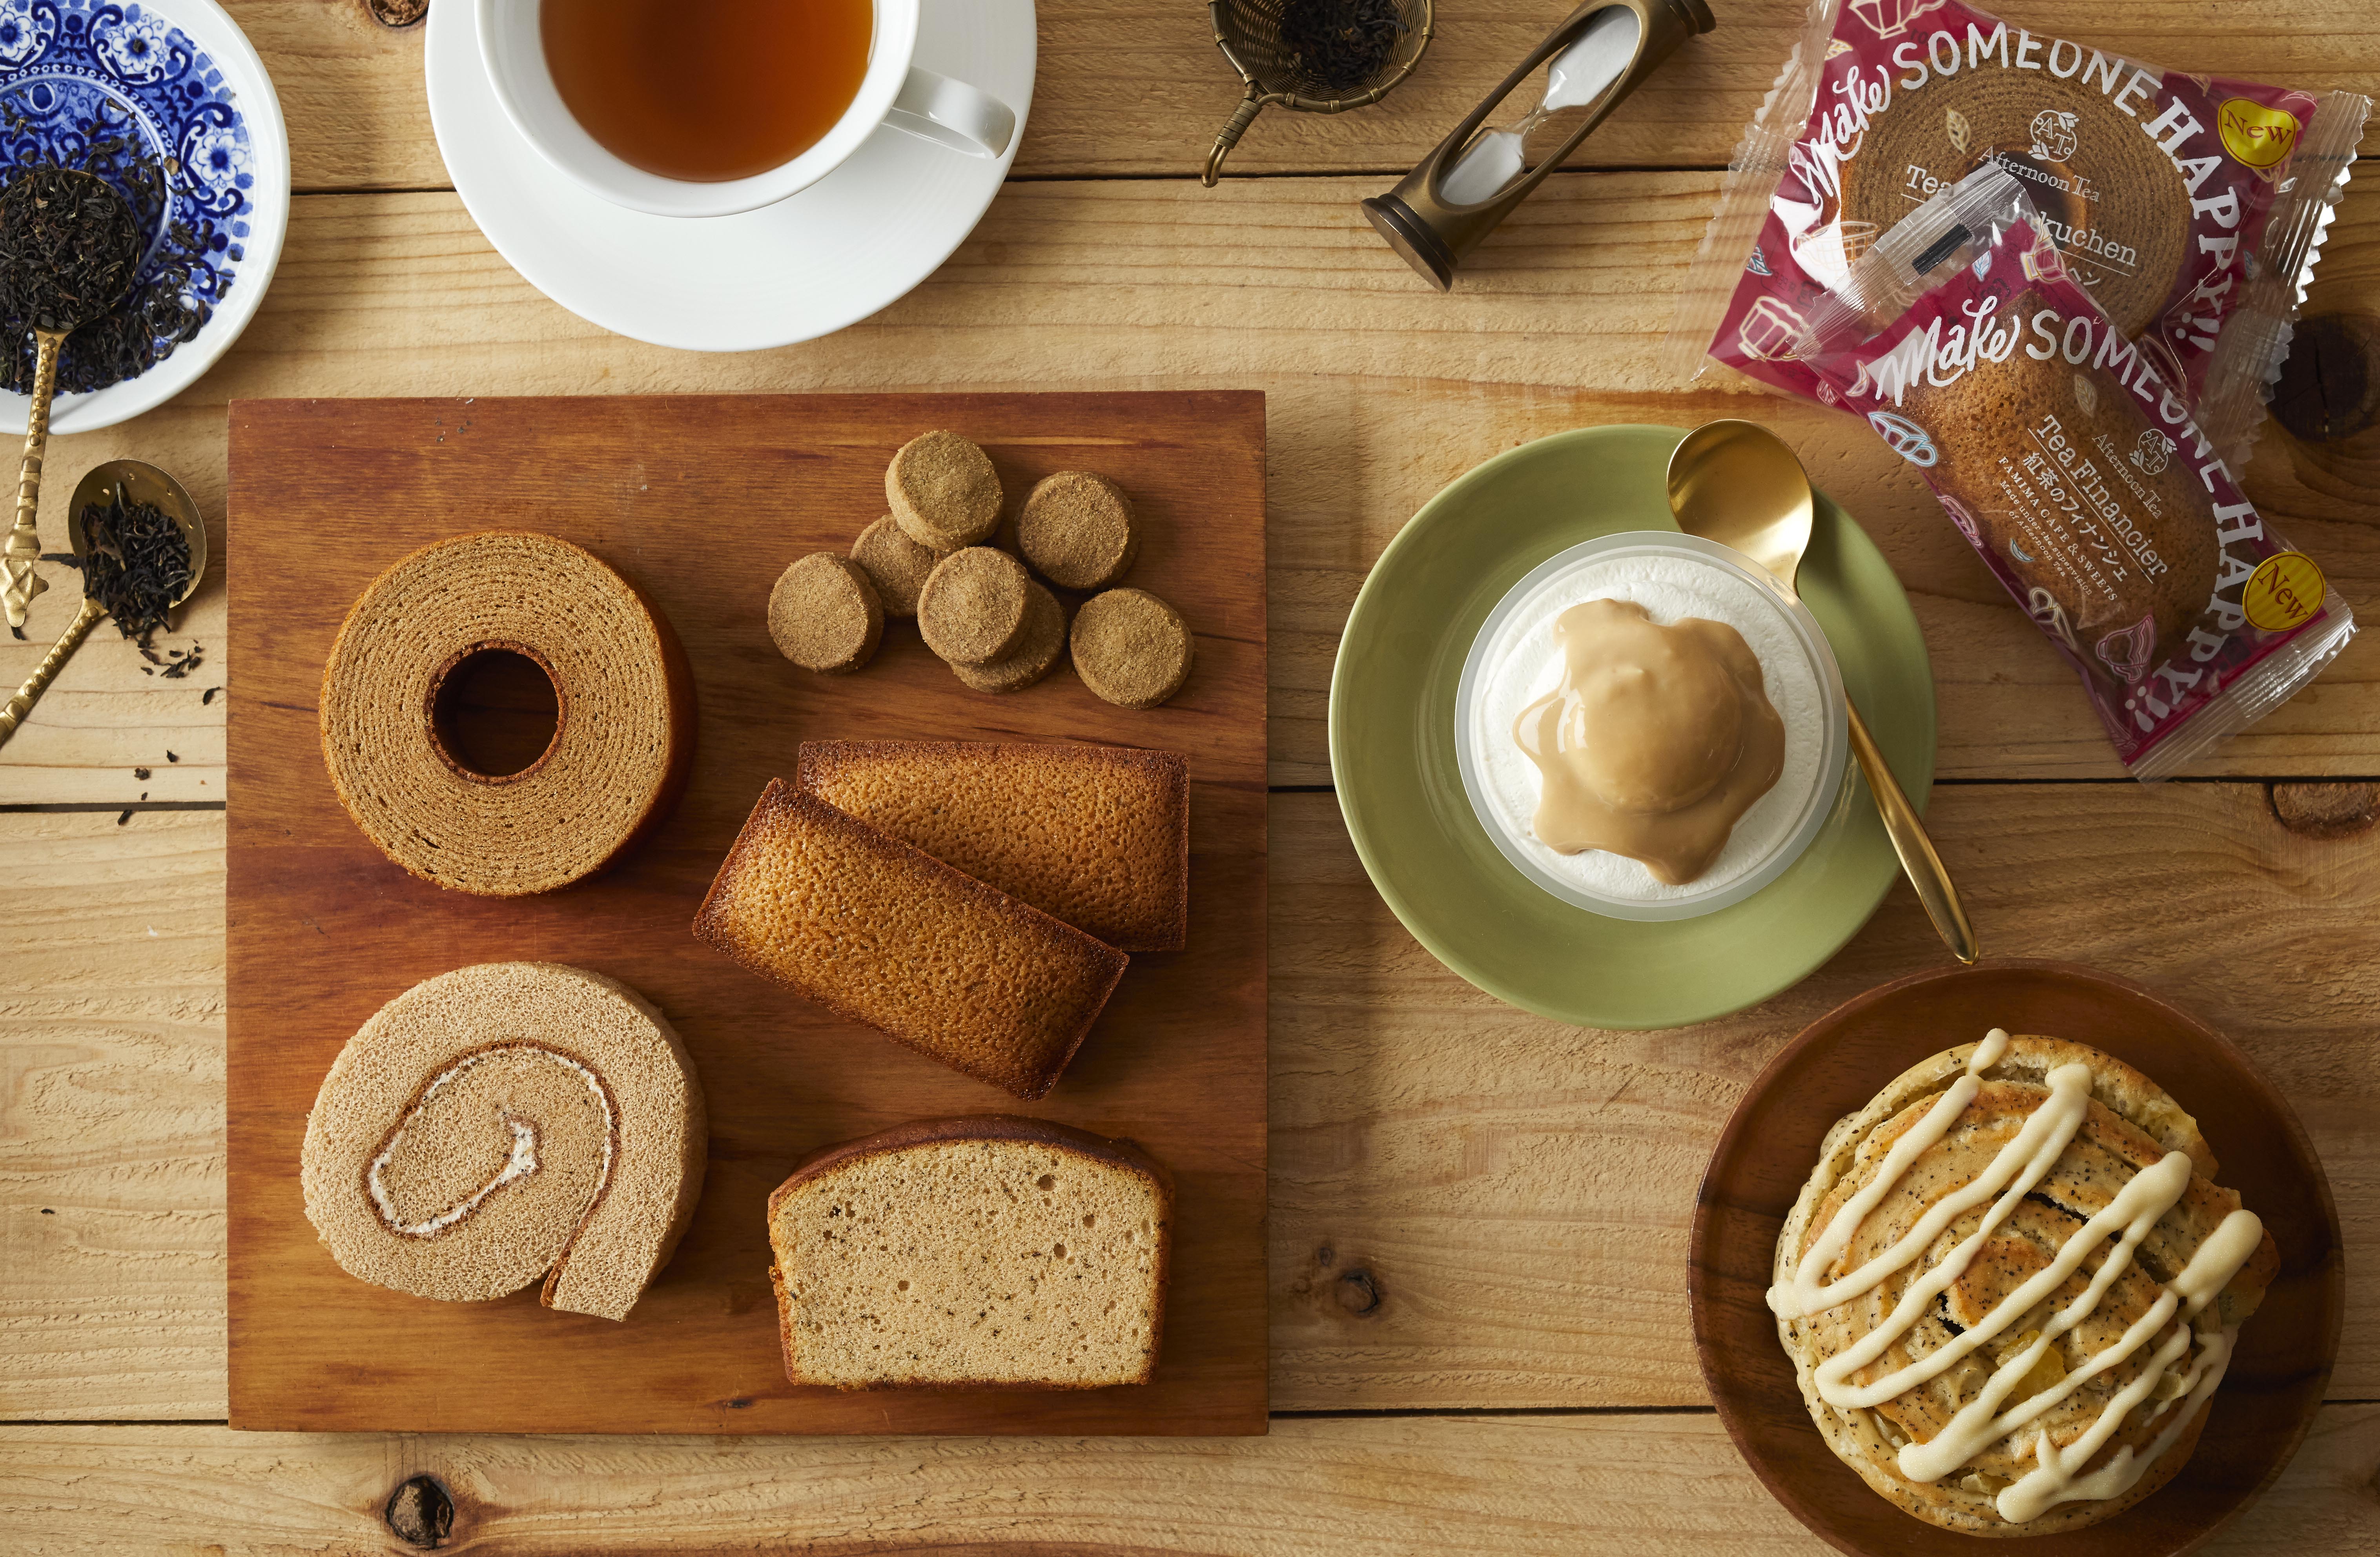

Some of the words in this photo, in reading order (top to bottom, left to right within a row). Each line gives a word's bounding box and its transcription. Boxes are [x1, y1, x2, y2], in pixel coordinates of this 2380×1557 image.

[1806, 64, 1891, 204] Make
[1893, 22, 2163, 117] SOMEONE
[2141, 96, 2240, 352] HAPPY!!
[1978, 145, 2070, 192] Afternoon
[2071, 175, 2100, 202] Tea
[1875, 295, 2021, 407] Make
[2026, 309, 2232, 493] SOMEONE
[1998, 456, 2039, 507] FAMIMA
[2067, 543, 2078, 556] &
[2077, 555, 2118, 601] SWEETS
[2000, 480, 2020, 505] Made
[2019, 505, 2041, 531] under
[2041, 531, 2053, 546] the
[2052, 547, 2092, 595] supervision
[2023, 452, 2128, 582] 紅茶のフィナンシェ
[2036, 414, 2076, 467] Tea
[2070, 458, 2168, 576] Financier
[2092, 434, 2146, 500] Afternoon
[2143, 490, 2162, 519] Tea
[2008, 511, 2019, 520] of
[2017, 521, 2053, 561] Afternoon
[2053, 561, 2066, 577] Tea
[2257, 563, 2309, 620] New
[2125, 502, 2264, 733] HAPPY!!
